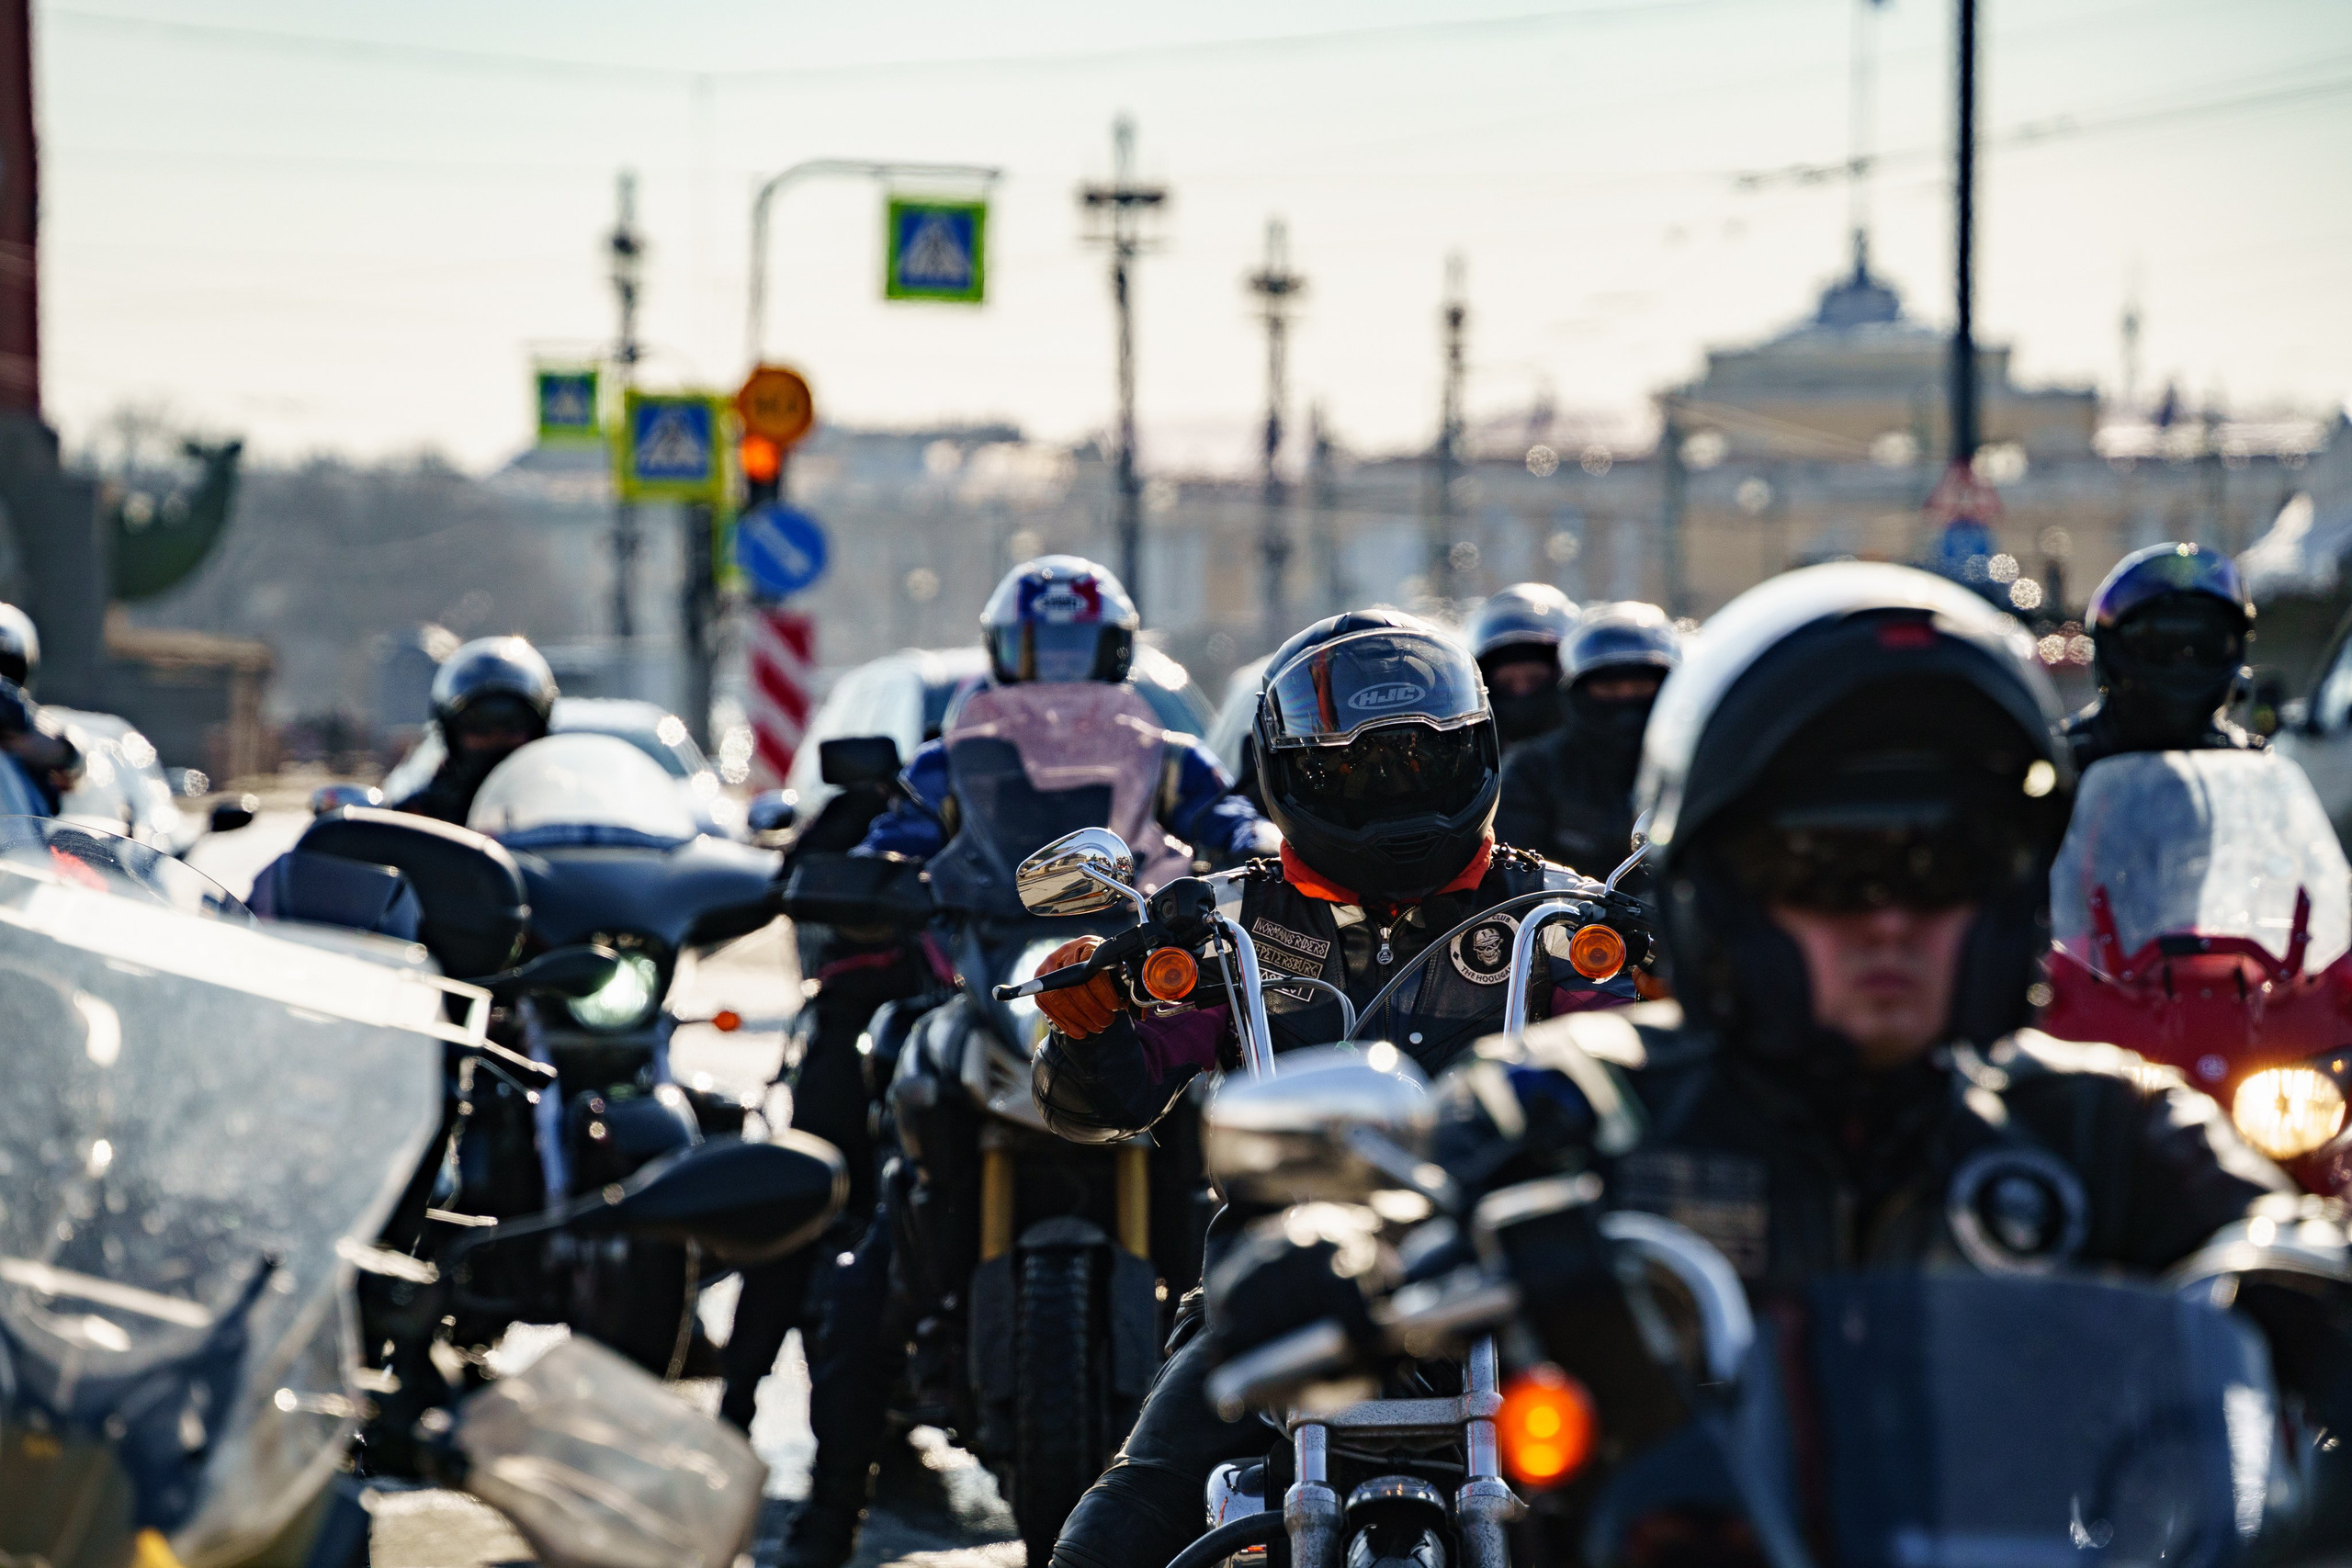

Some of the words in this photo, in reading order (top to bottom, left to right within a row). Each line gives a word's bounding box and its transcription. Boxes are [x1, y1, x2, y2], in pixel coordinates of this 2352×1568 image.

[1359, 686, 1416, 706] HJC
[1492, 914, 1510, 923] CLUB
[1256, 919, 1295, 945] NORMANS
[1295, 935, 1327, 955] RIDERS
[1461, 965, 1476, 979] THE
